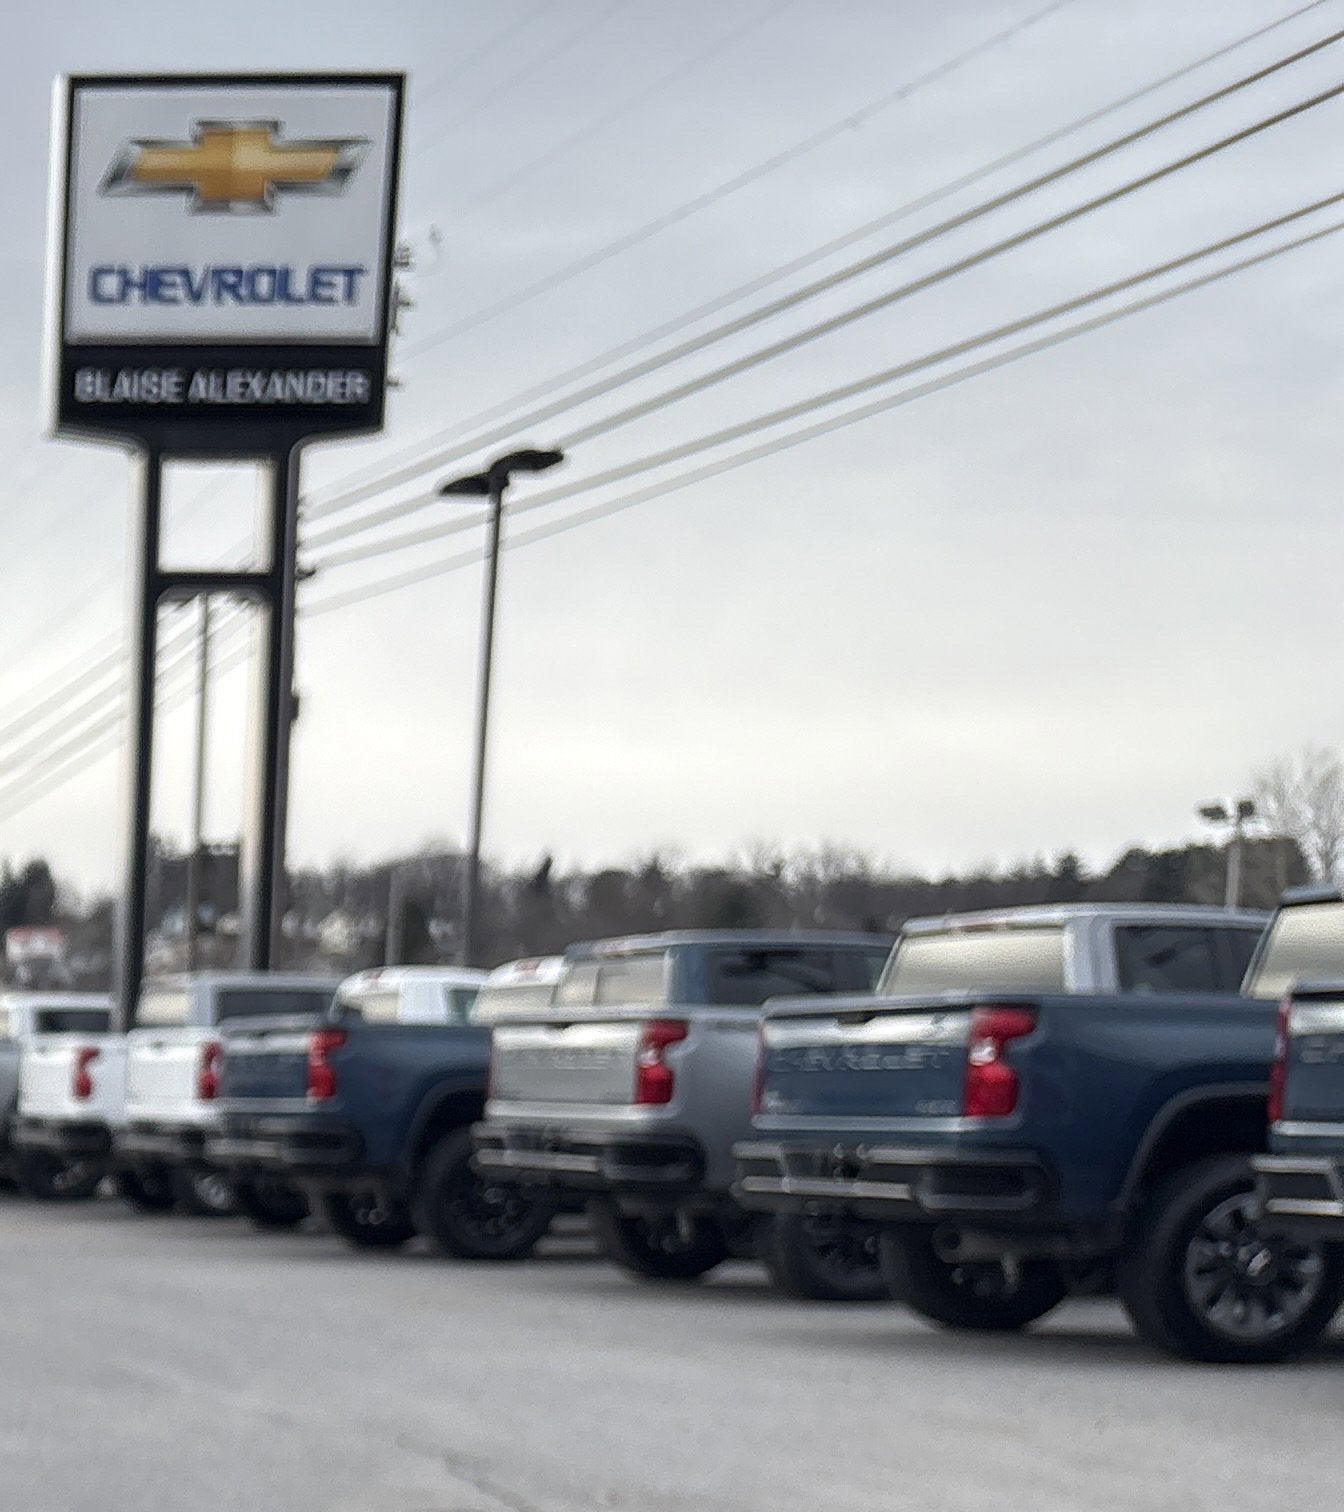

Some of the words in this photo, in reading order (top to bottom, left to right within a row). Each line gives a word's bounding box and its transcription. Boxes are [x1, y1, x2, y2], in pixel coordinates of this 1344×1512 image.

[87, 265, 368, 306] CHEVROLET
[74, 368, 185, 402] BLAISE
[188, 369, 370, 403] ALEXANDER
